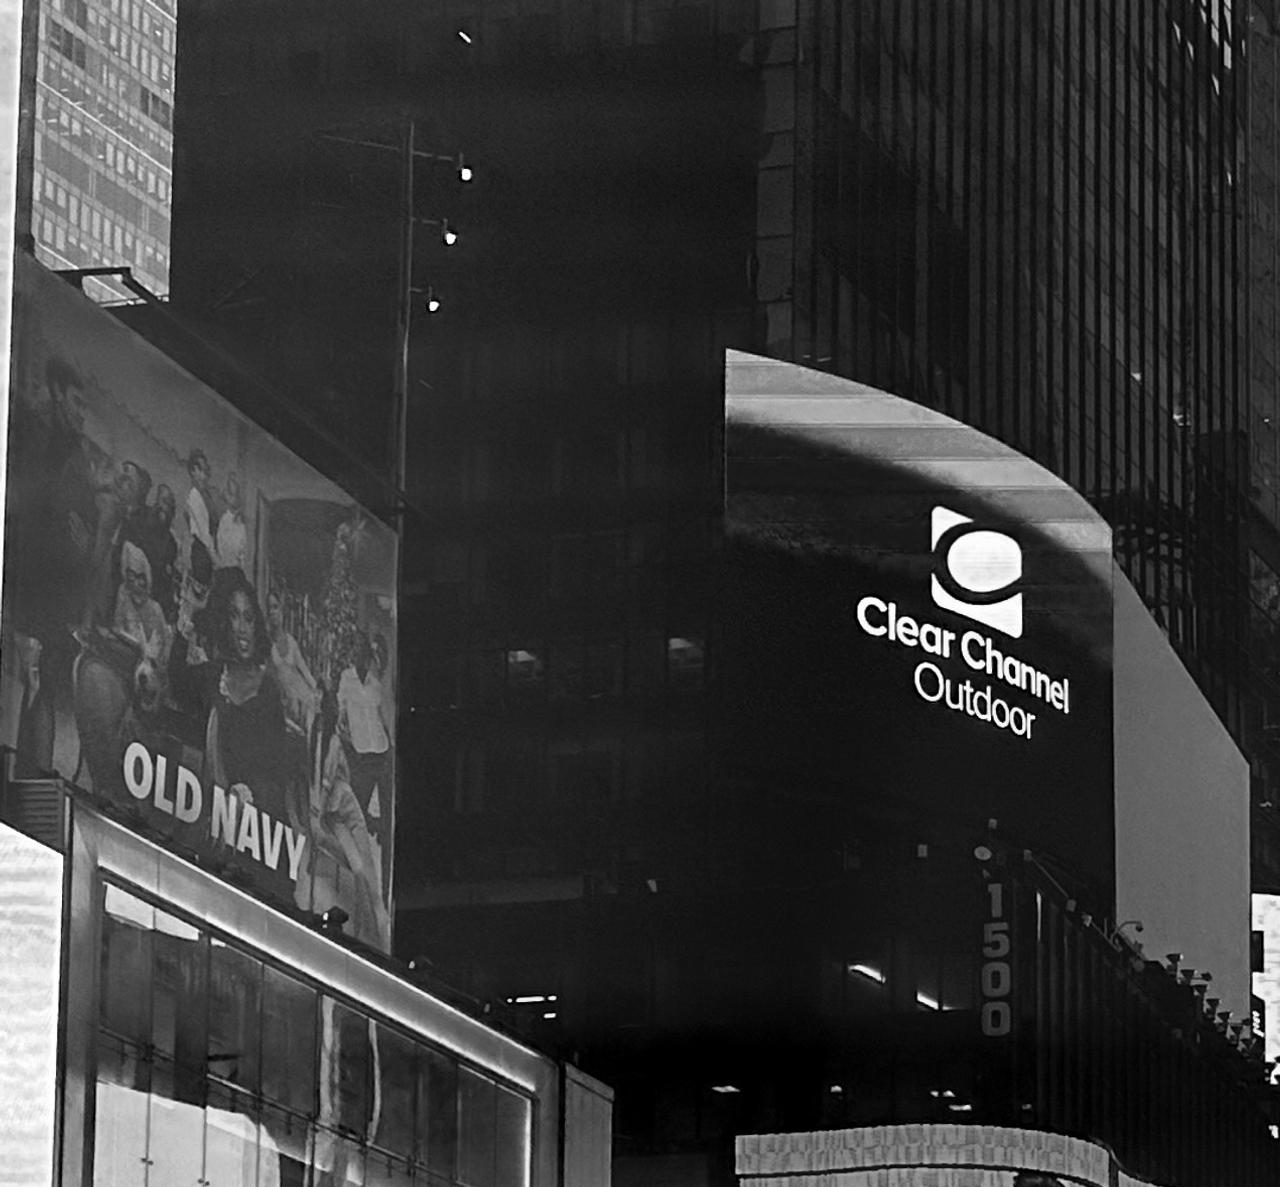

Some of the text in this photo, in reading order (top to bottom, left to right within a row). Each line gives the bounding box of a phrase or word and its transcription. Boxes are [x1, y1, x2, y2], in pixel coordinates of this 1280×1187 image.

[856, 595, 1070, 715] Clear Channel
[913, 660, 1037, 740] Outdoor
[122, 741, 307, 882] OLD NAVY
[980, 882, 1012, 1037] 1500
